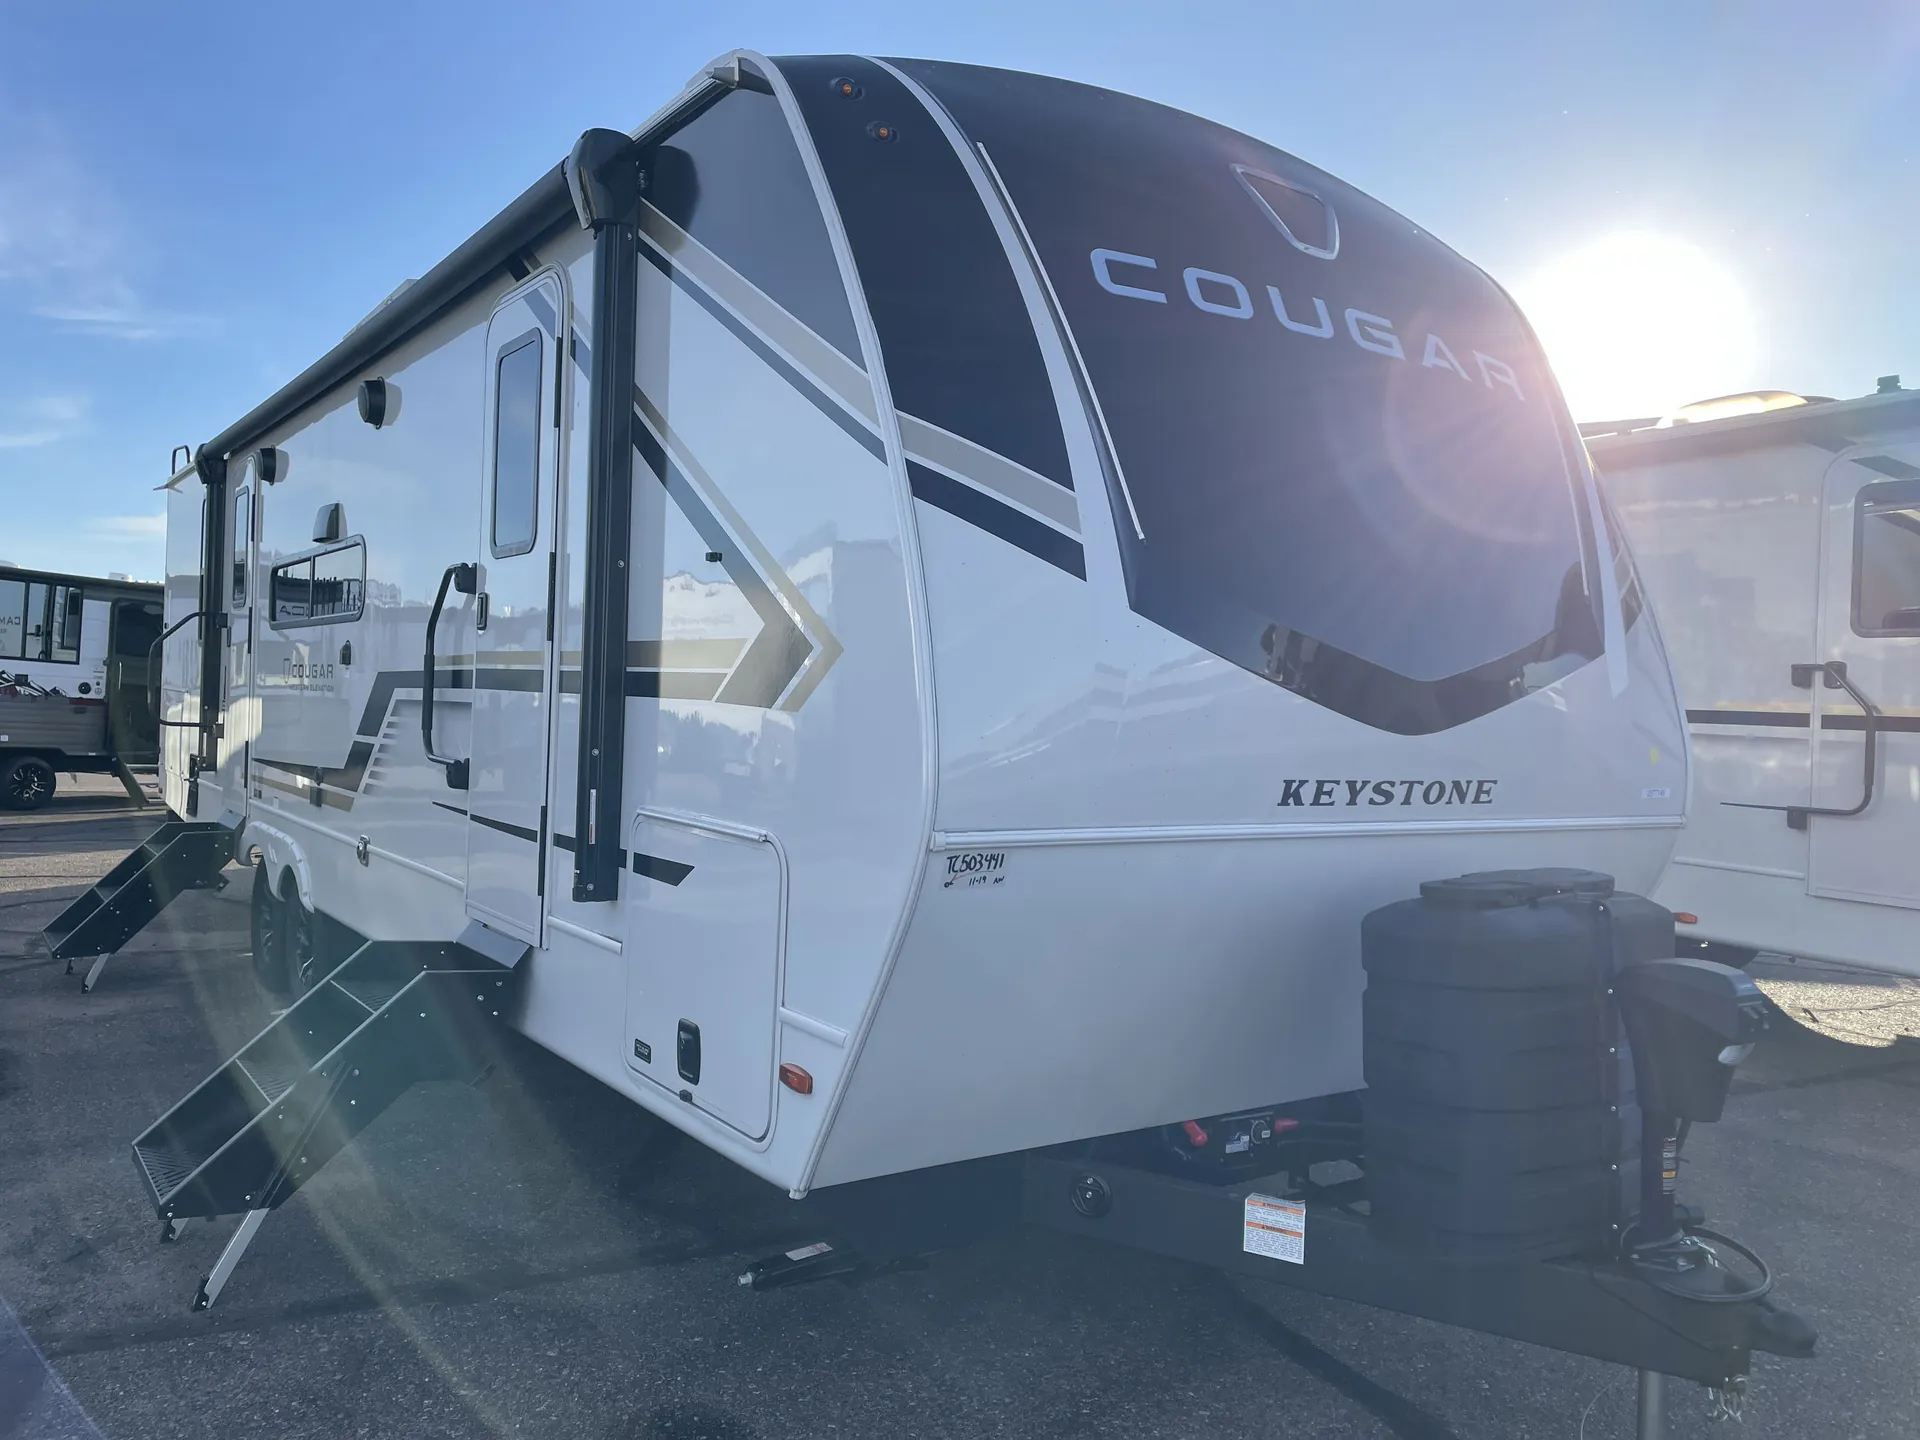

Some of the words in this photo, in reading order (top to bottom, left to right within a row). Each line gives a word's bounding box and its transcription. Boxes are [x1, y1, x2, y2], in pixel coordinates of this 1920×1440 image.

[1090, 248, 1525, 401] COUGAR
[292, 663, 333, 679] COUGAR
[1277, 779, 1498, 807] KEYSTONE
